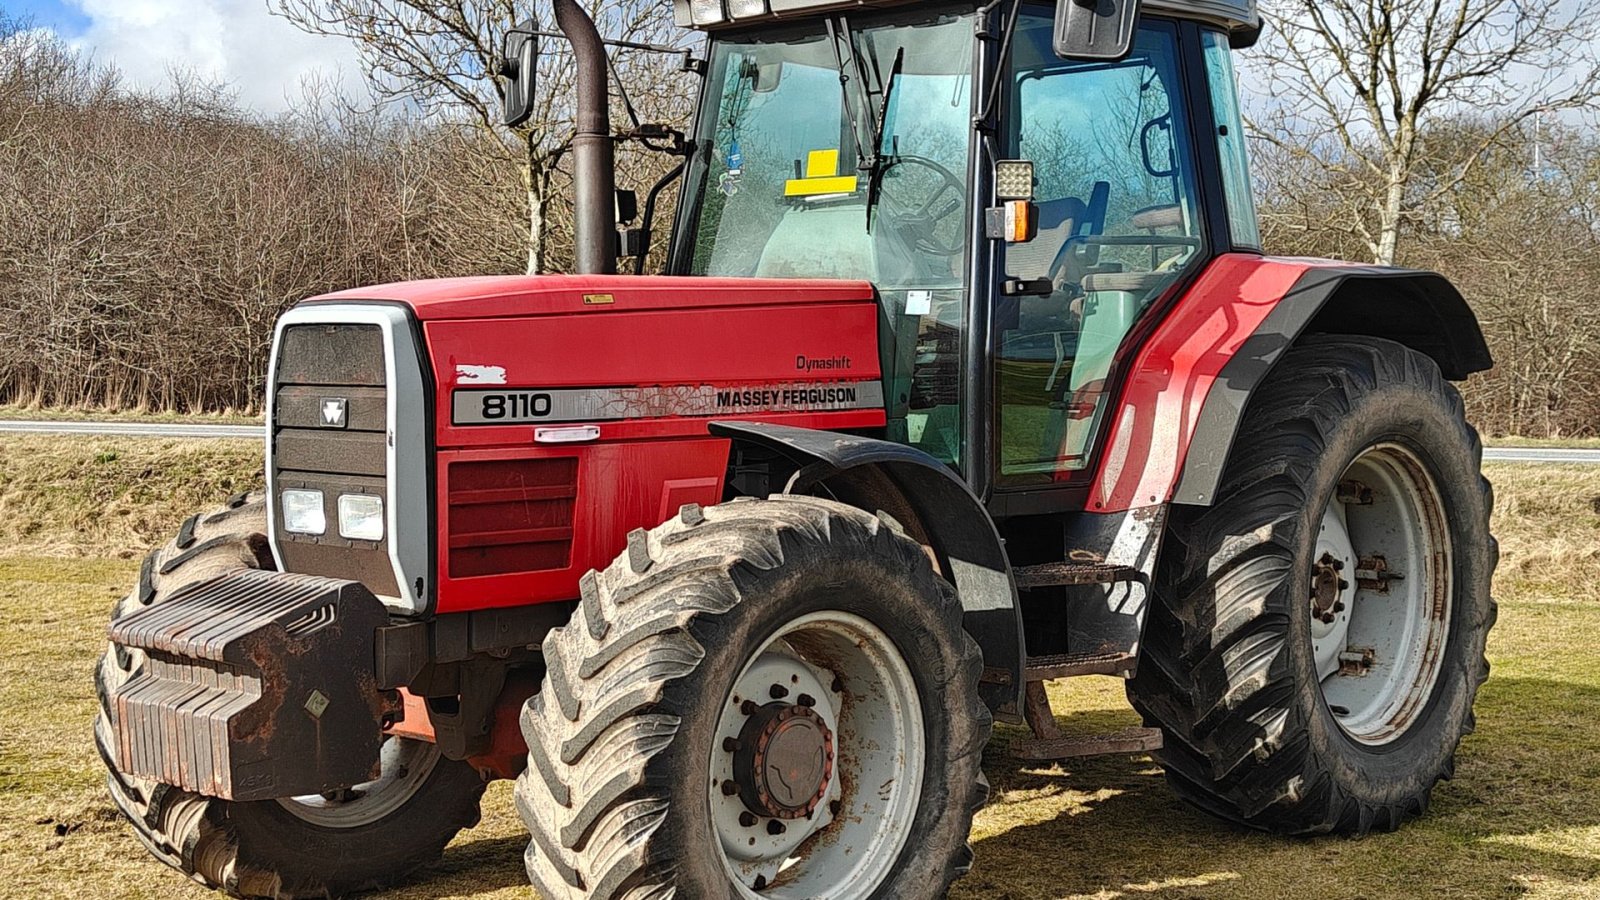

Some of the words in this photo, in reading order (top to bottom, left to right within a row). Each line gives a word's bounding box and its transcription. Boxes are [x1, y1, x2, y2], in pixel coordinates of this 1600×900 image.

[796, 355, 852, 373] Dynashift
[482, 393, 552, 419] 8110
[717, 390, 780, 407] MASSEY
[783, 387, 857, 405] FERGUSON
